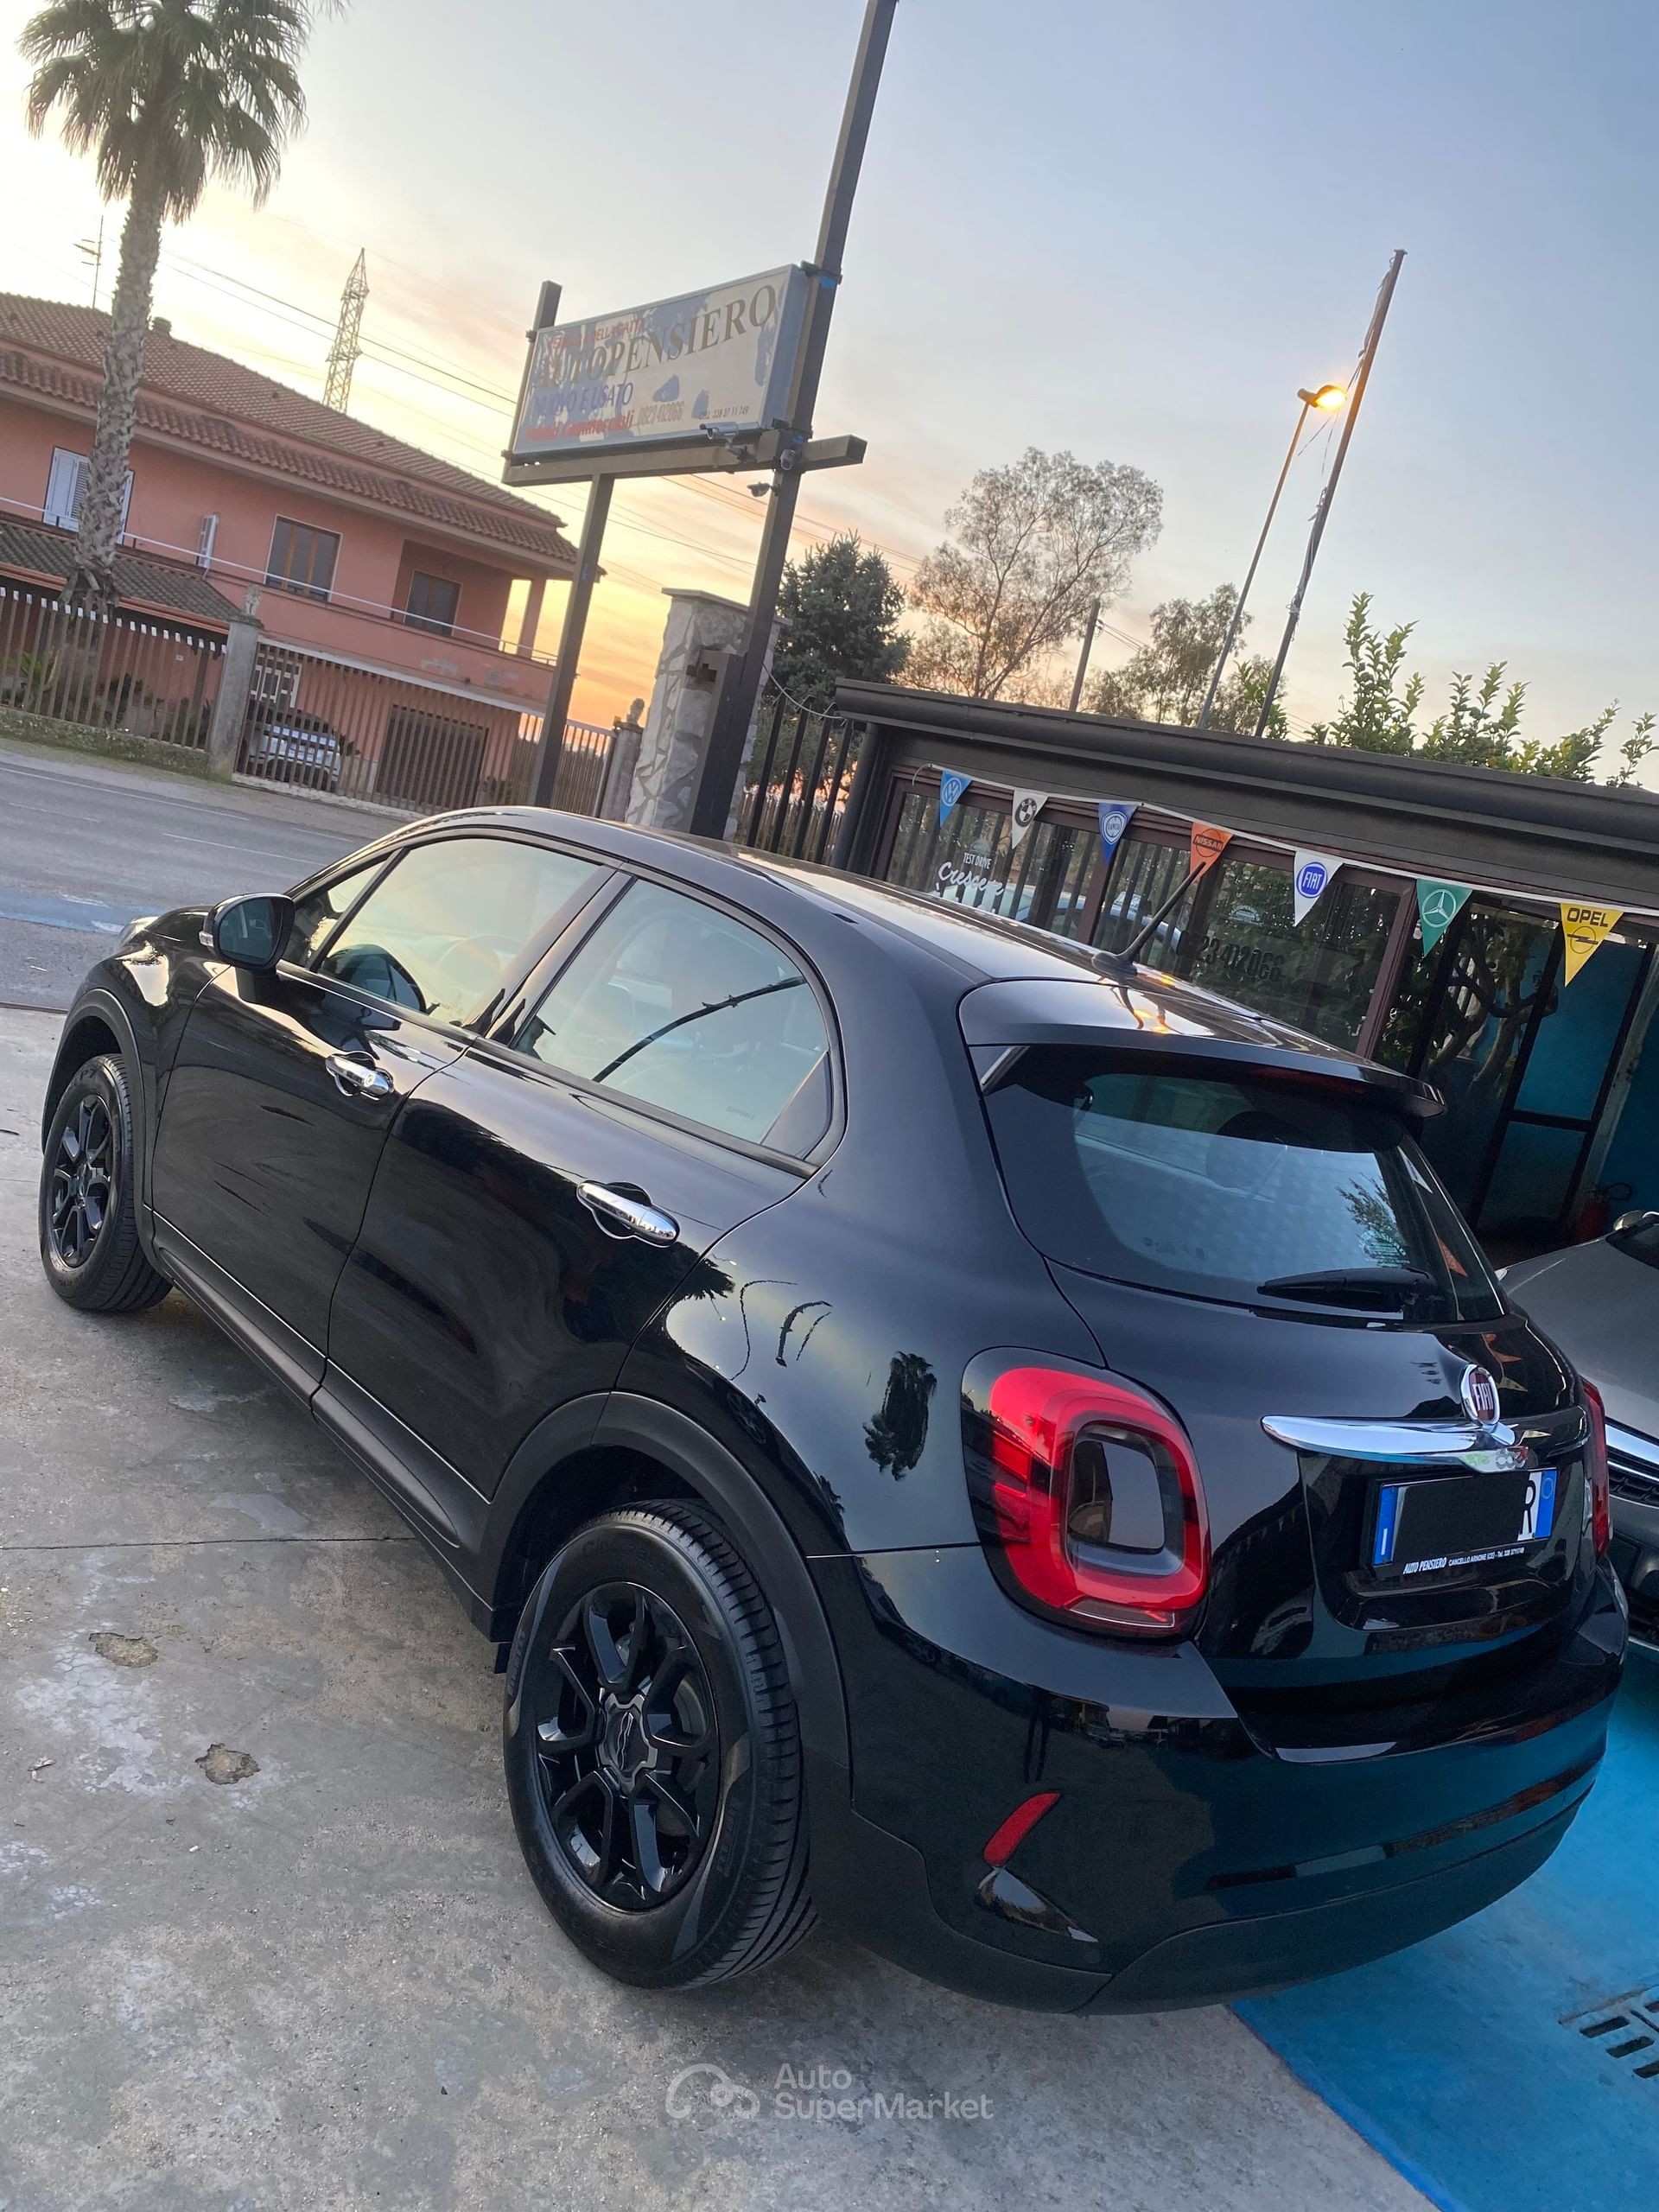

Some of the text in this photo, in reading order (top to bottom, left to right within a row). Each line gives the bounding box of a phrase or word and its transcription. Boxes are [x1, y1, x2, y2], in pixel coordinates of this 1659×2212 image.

[1194, 835, 1224, 851] NISSAN
[963, 852, 992, 869] TEST DRIVE
[1302, 871, 1323, 890] FIAT
[1567, 907, 1609, 928] OPEL
[1471, 1382, 1494, 1411] FIAT
